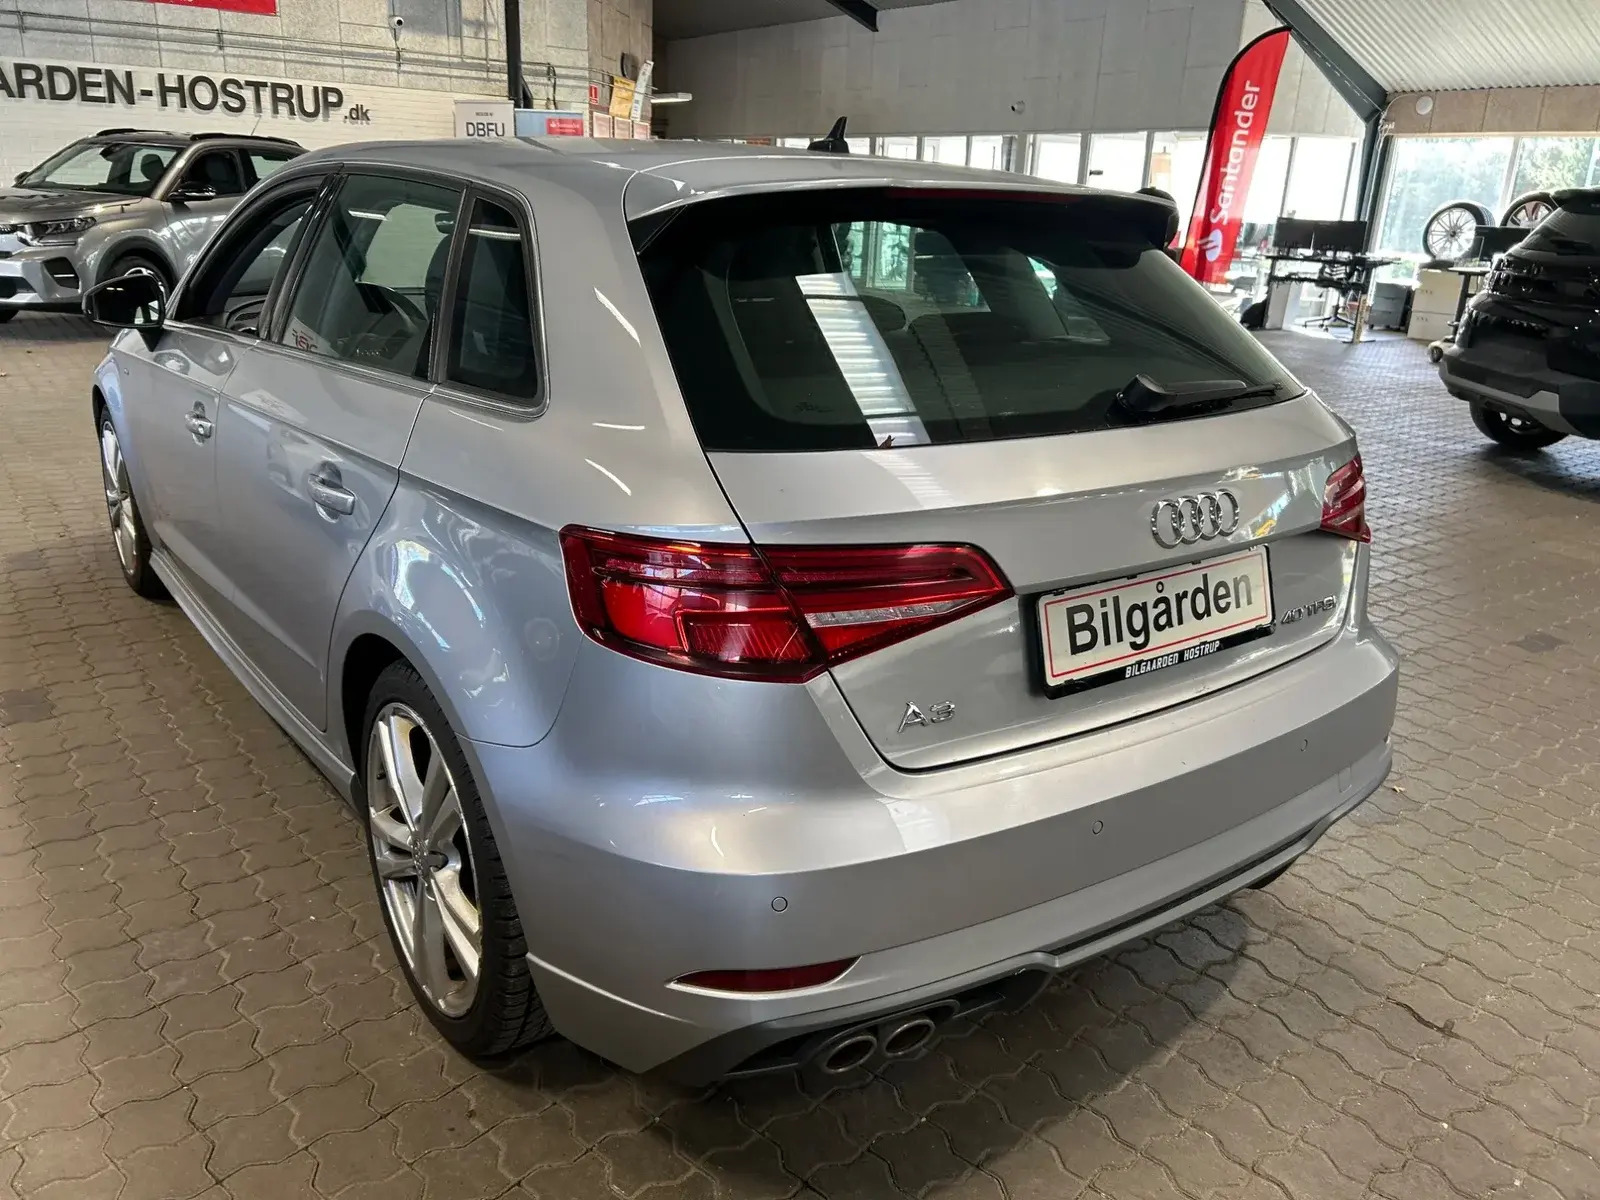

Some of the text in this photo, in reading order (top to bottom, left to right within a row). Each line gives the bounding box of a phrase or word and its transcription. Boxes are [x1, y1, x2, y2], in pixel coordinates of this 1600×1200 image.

[465, 121, 505, 137] DBFU
[1209, 79, 1261, 226] Santander
[1065, 571, 1253, 656] Bilgården
[1125, 640, 1220, 678] BILGAARDEN HOSTRUP
[897, 701, 955, 733] A3
